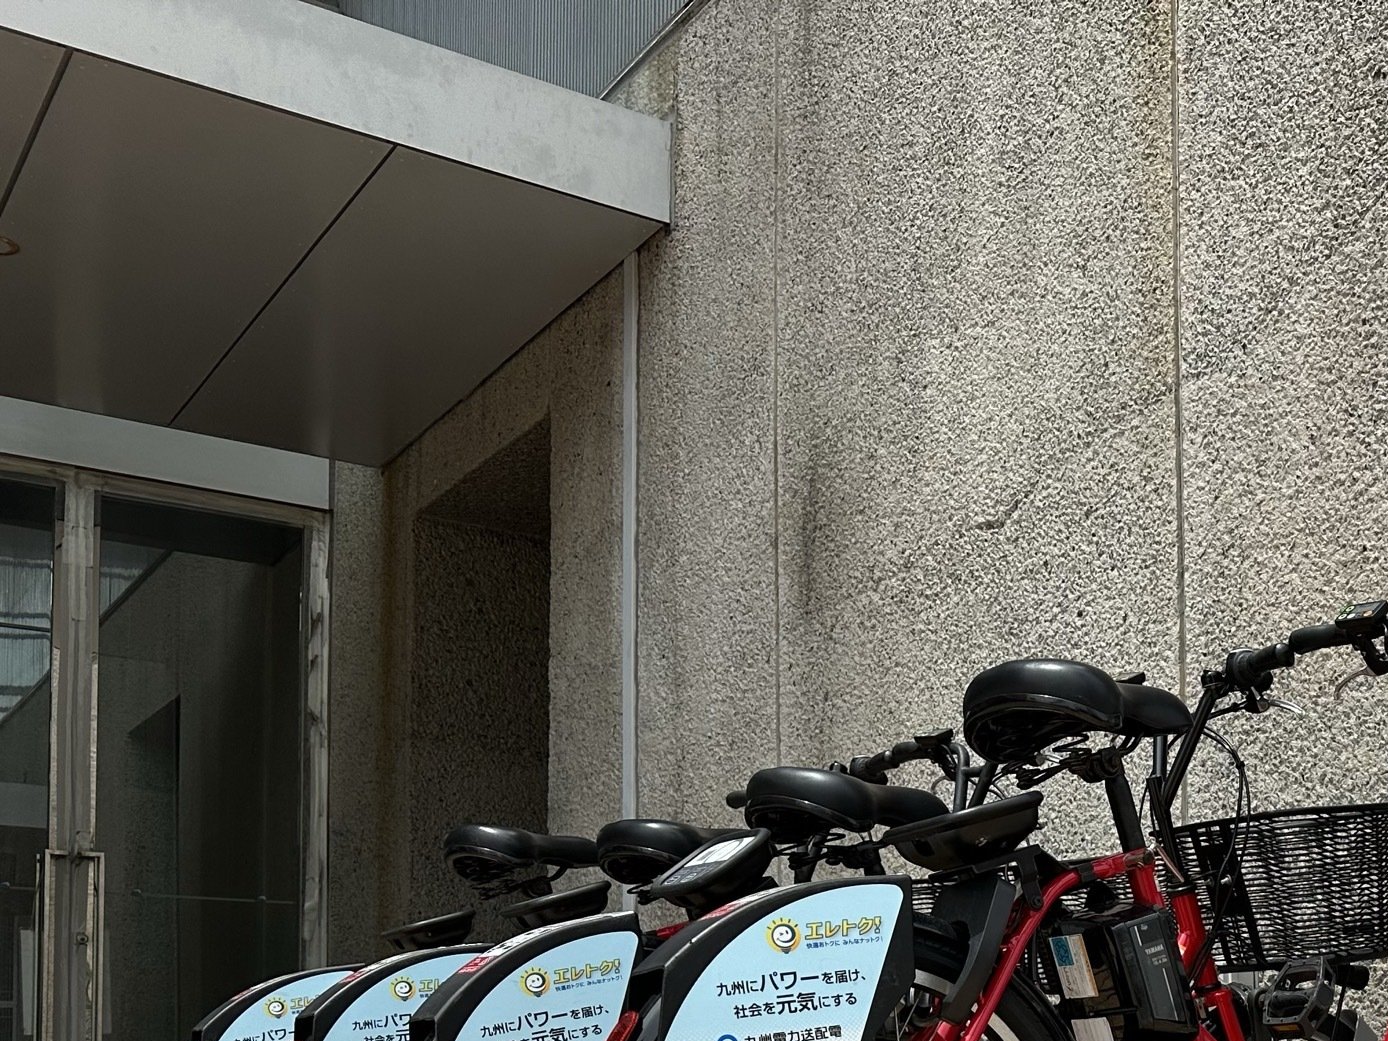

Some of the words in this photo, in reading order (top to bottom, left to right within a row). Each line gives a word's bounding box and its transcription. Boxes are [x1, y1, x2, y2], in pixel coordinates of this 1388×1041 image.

[805, 916, 881, 940] エレトク!
[554, 959, 620, 984] エレトク!
[716, 969, 866, 997] 九州にパワーを届け、
[733, 992, 858, 1019] 社会を元気にする
[480, 1004, 609, 1038] 九州にパワーを届け、
